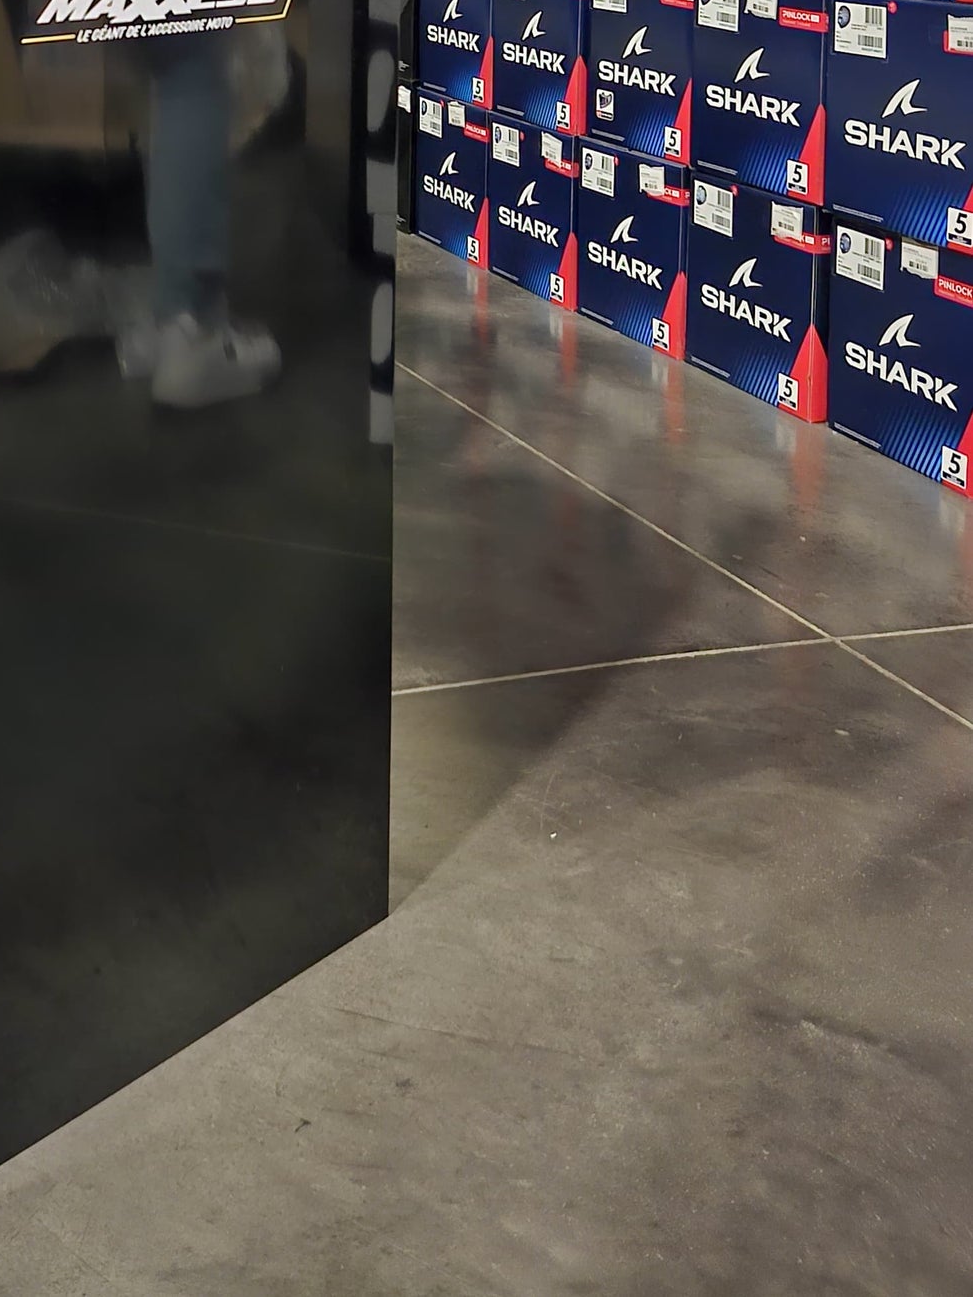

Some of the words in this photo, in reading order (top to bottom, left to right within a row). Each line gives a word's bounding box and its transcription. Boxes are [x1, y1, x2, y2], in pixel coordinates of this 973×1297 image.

[782, 10, 811, 22] PINLOCK
[77, 29, 92, 43] LE
[92, 23, 126, 41] GÉANT
[127, 23, 140, 39] DE
[141, 19, 206, 38] L'ACCESSOIRE
[207, 15, 234, 31] MOTO
[427, 24, 480, 53] SHARK
[502, 42, 566, 75] SHARK
[475, 80, 482, 94] 5
[598, 60, 675, 97] SHARK
[559, 105, 567, 121] 5
[706, 84, 801, 127] SHARK
[668, 130, 677, 147] 5
[844, 119, 966, 170] SHARK
[793, 165, 802, 183] 5
[423, 175, 476, 213] SHARK
[498, 206, 560, 248] SHARK
[954, 212, 968, 234] 5
[470, 240, 476, 255] 5
[587, 241, 664, 290] SHARK
[553, 277, 560, 293] 5
[938, 278, 973, 298] PINLOCK
[701, 283, 792, 343] SHARK
[656, 321, 665, 339] 5
[845, 341, 959, 412] SHARK
[784, 379, 793, 398] 5
[948, 452, 961, 474] 5
